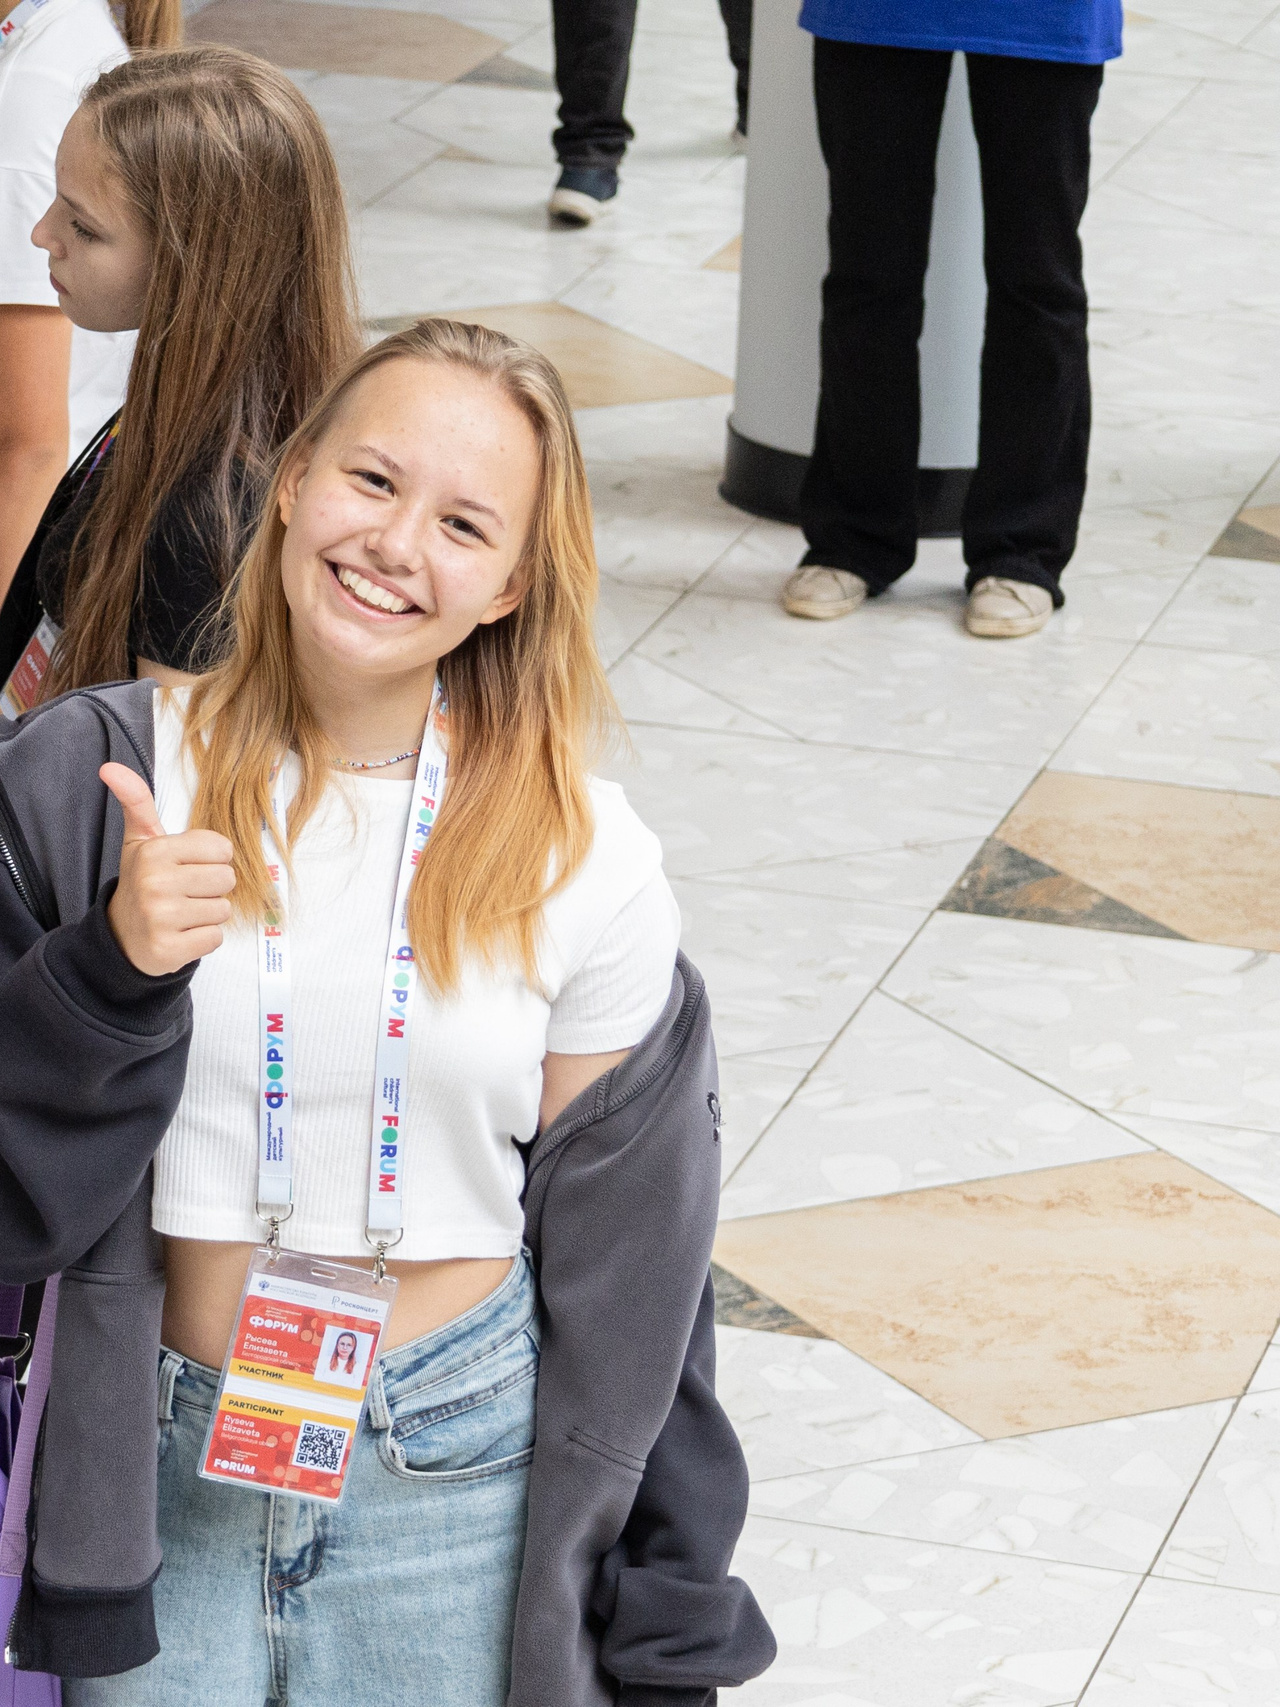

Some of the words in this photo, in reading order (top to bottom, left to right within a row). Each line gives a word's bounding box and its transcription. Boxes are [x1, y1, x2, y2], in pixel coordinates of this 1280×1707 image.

[387, 945, 415, 1038] ФОРУМ
[264, 1013, 289, 1109] ФОРУМ
[378, 1115, 399, 1193] FORUM
[340, 1300, 379, 1314] РОСКОНЦЕРТ
[249, 1315, 299, 1335] ФОРУМ
[245, 1333, 278, 1347] Рысева
[243, 1342, 289, 1358] Елизавета
[238, 1364, 284, 1380] УЧАСТНИК
[228, 1399, 285, 1416] PARTICIPANT
[224, 1414, 255, 1428] Ryseva
[222, 1423, 261, 1438] Elizaveta
[213, 1458, 256, 1475] FORUM
